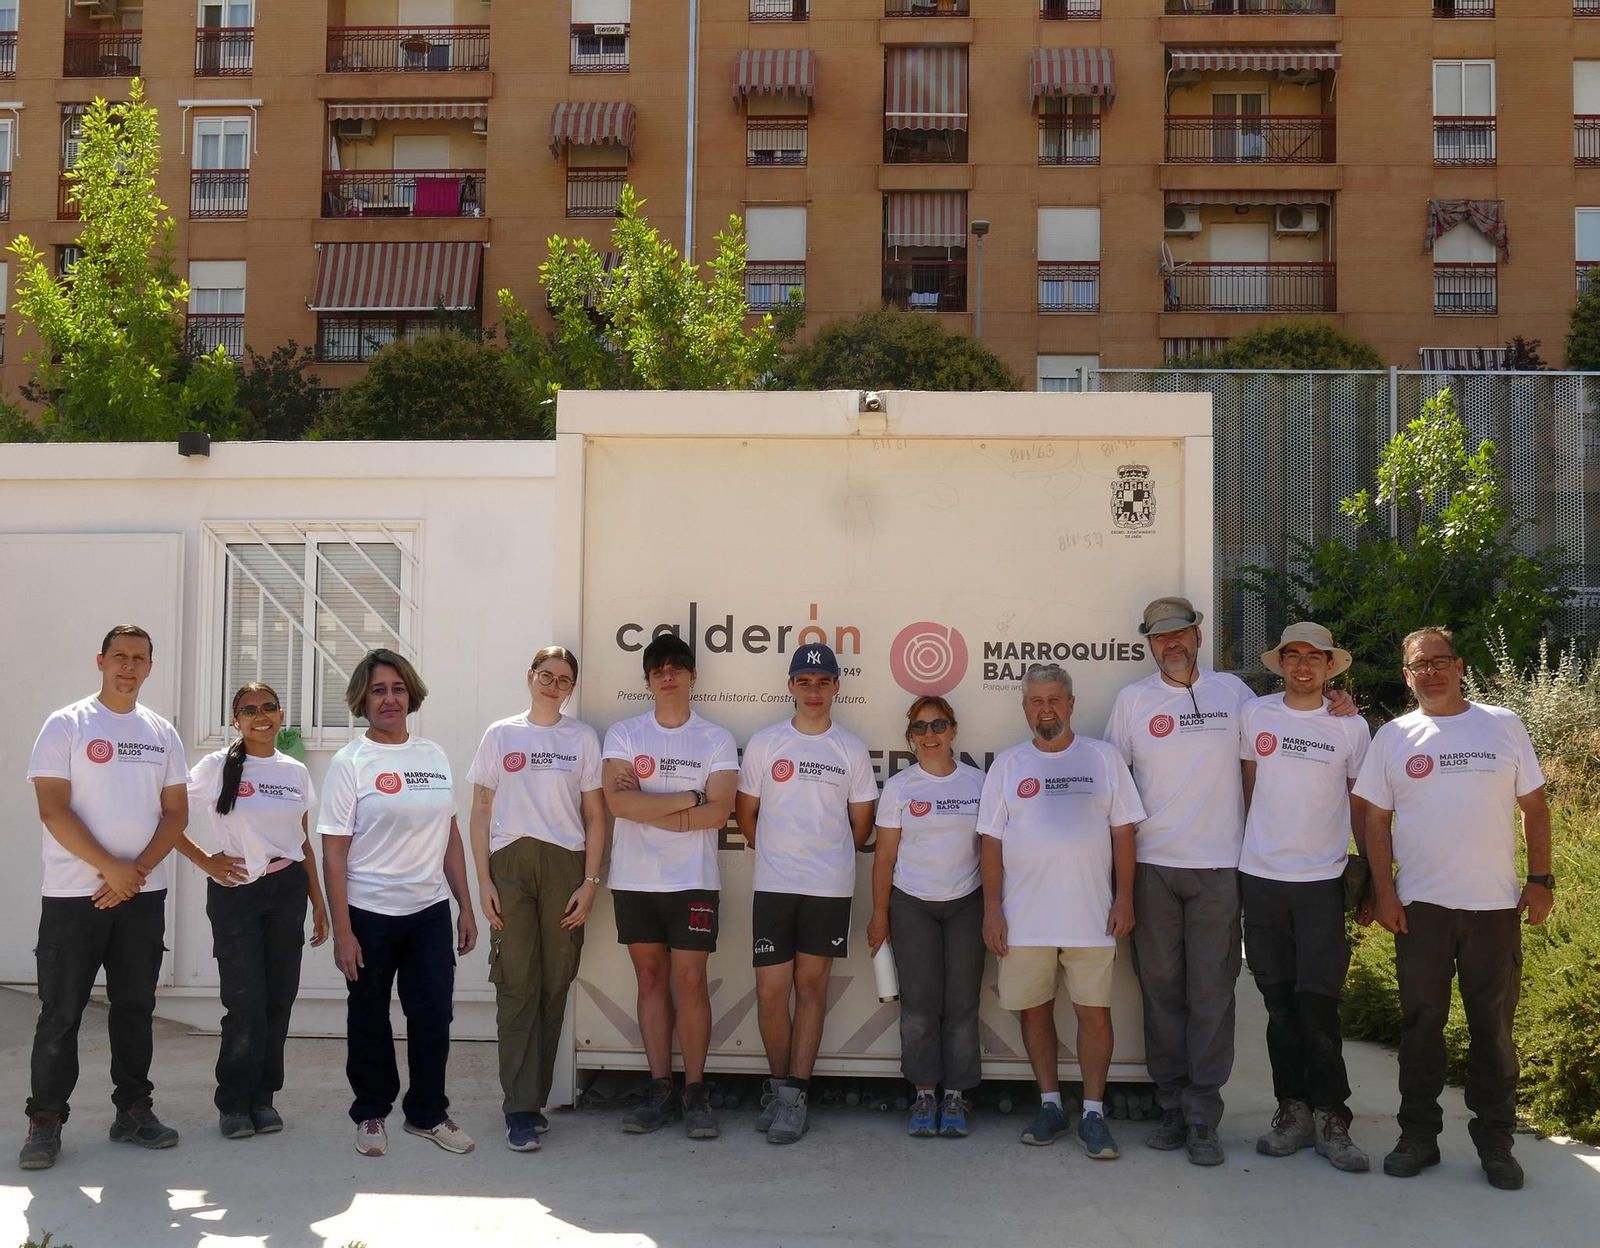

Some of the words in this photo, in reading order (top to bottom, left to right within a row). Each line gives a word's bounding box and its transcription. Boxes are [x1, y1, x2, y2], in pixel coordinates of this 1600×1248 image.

[983, 638, 1146, 661] MARROQUÍES
[983, 662, 1061, 681] BAJ
[983, 683, 1009, 692] Parque
[719, 692, 758, 702] historia.
[834, 693, 867, 704] futuro.
[118, 742, 165, 753] MARROQUÍES
[1282, 737, 1335, 752] MARROQUÍES
[1282, 743, 1307, 753] BAJOS
[530, 752, 577, 761] MARROQUÍES
[1439, 752, 1496, 760] MARROQUÍES
[799, 761, 845, 775] MARROQUÍES
[1440, 759, 1468, 767] BAJOS
[403, 771, 447, 780] MARROQUÍES
[1045, 776, 1093, 784] MARROQUÍES
